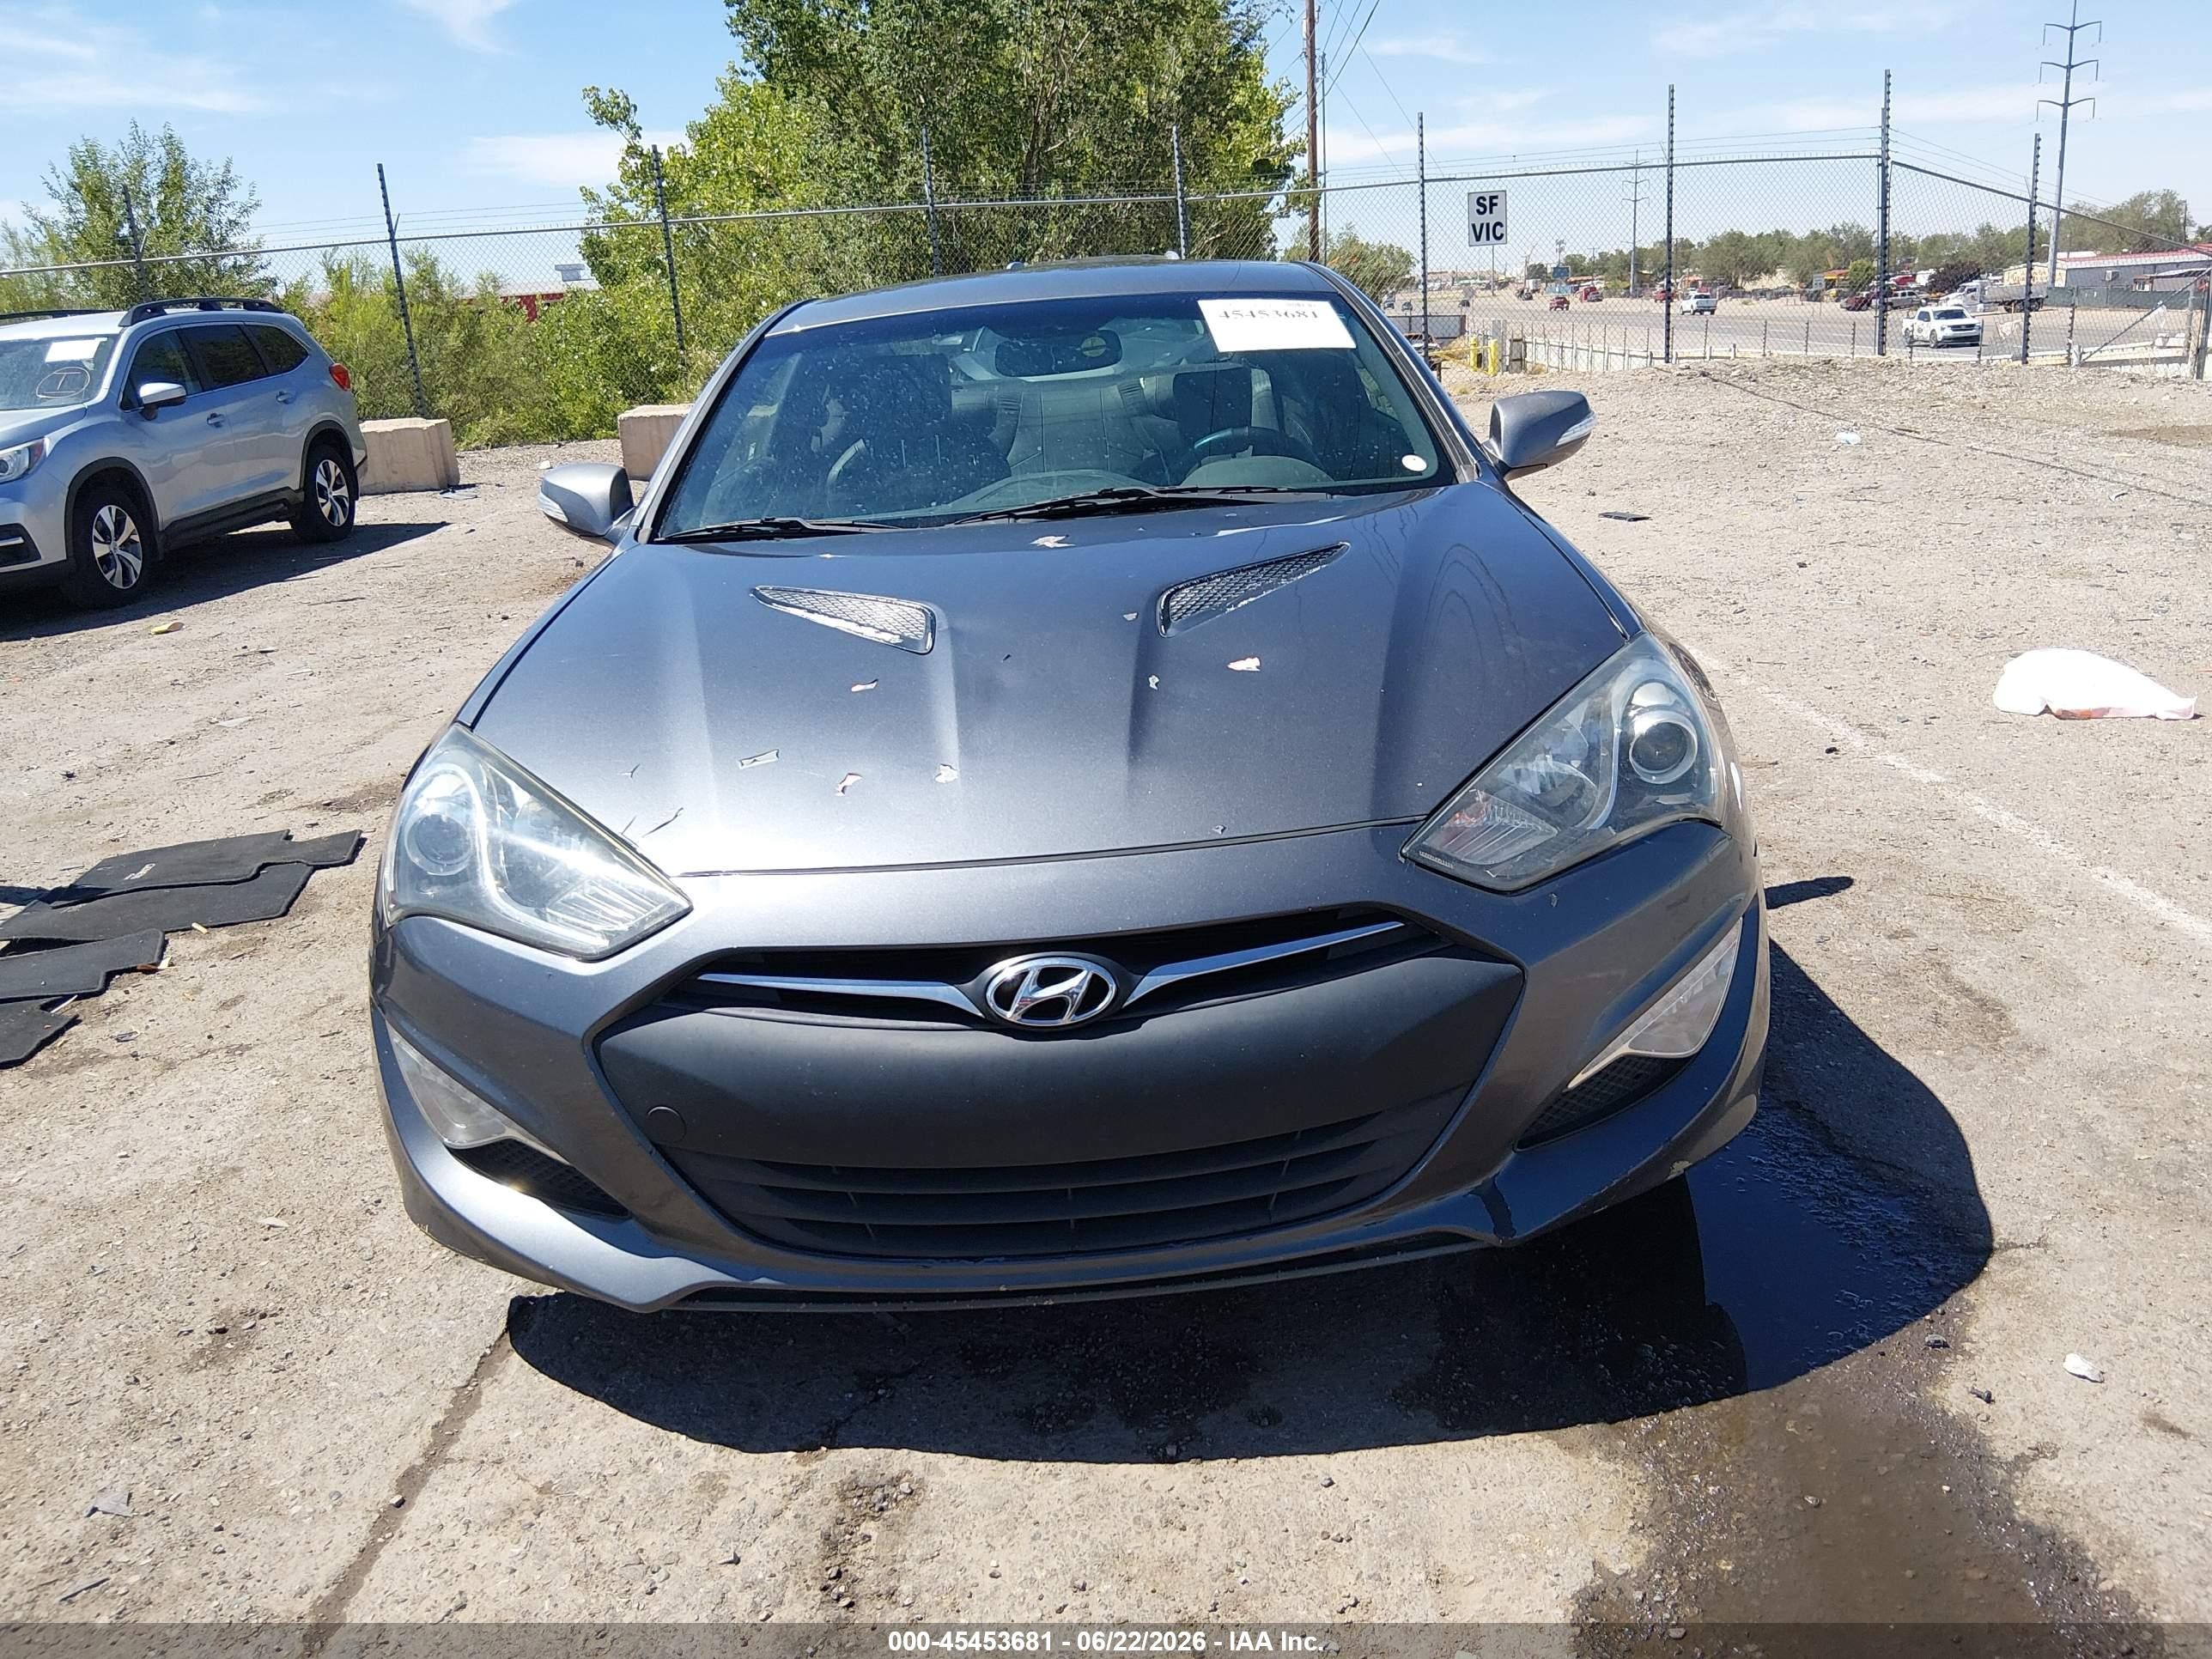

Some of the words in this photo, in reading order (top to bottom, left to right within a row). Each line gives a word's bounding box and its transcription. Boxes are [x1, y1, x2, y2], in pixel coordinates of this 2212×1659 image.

[1475, 195, 1499, 216] SF
[1471, 221, 1504, 242] VIC
[1218, 310, 1318, 319] 45453681
